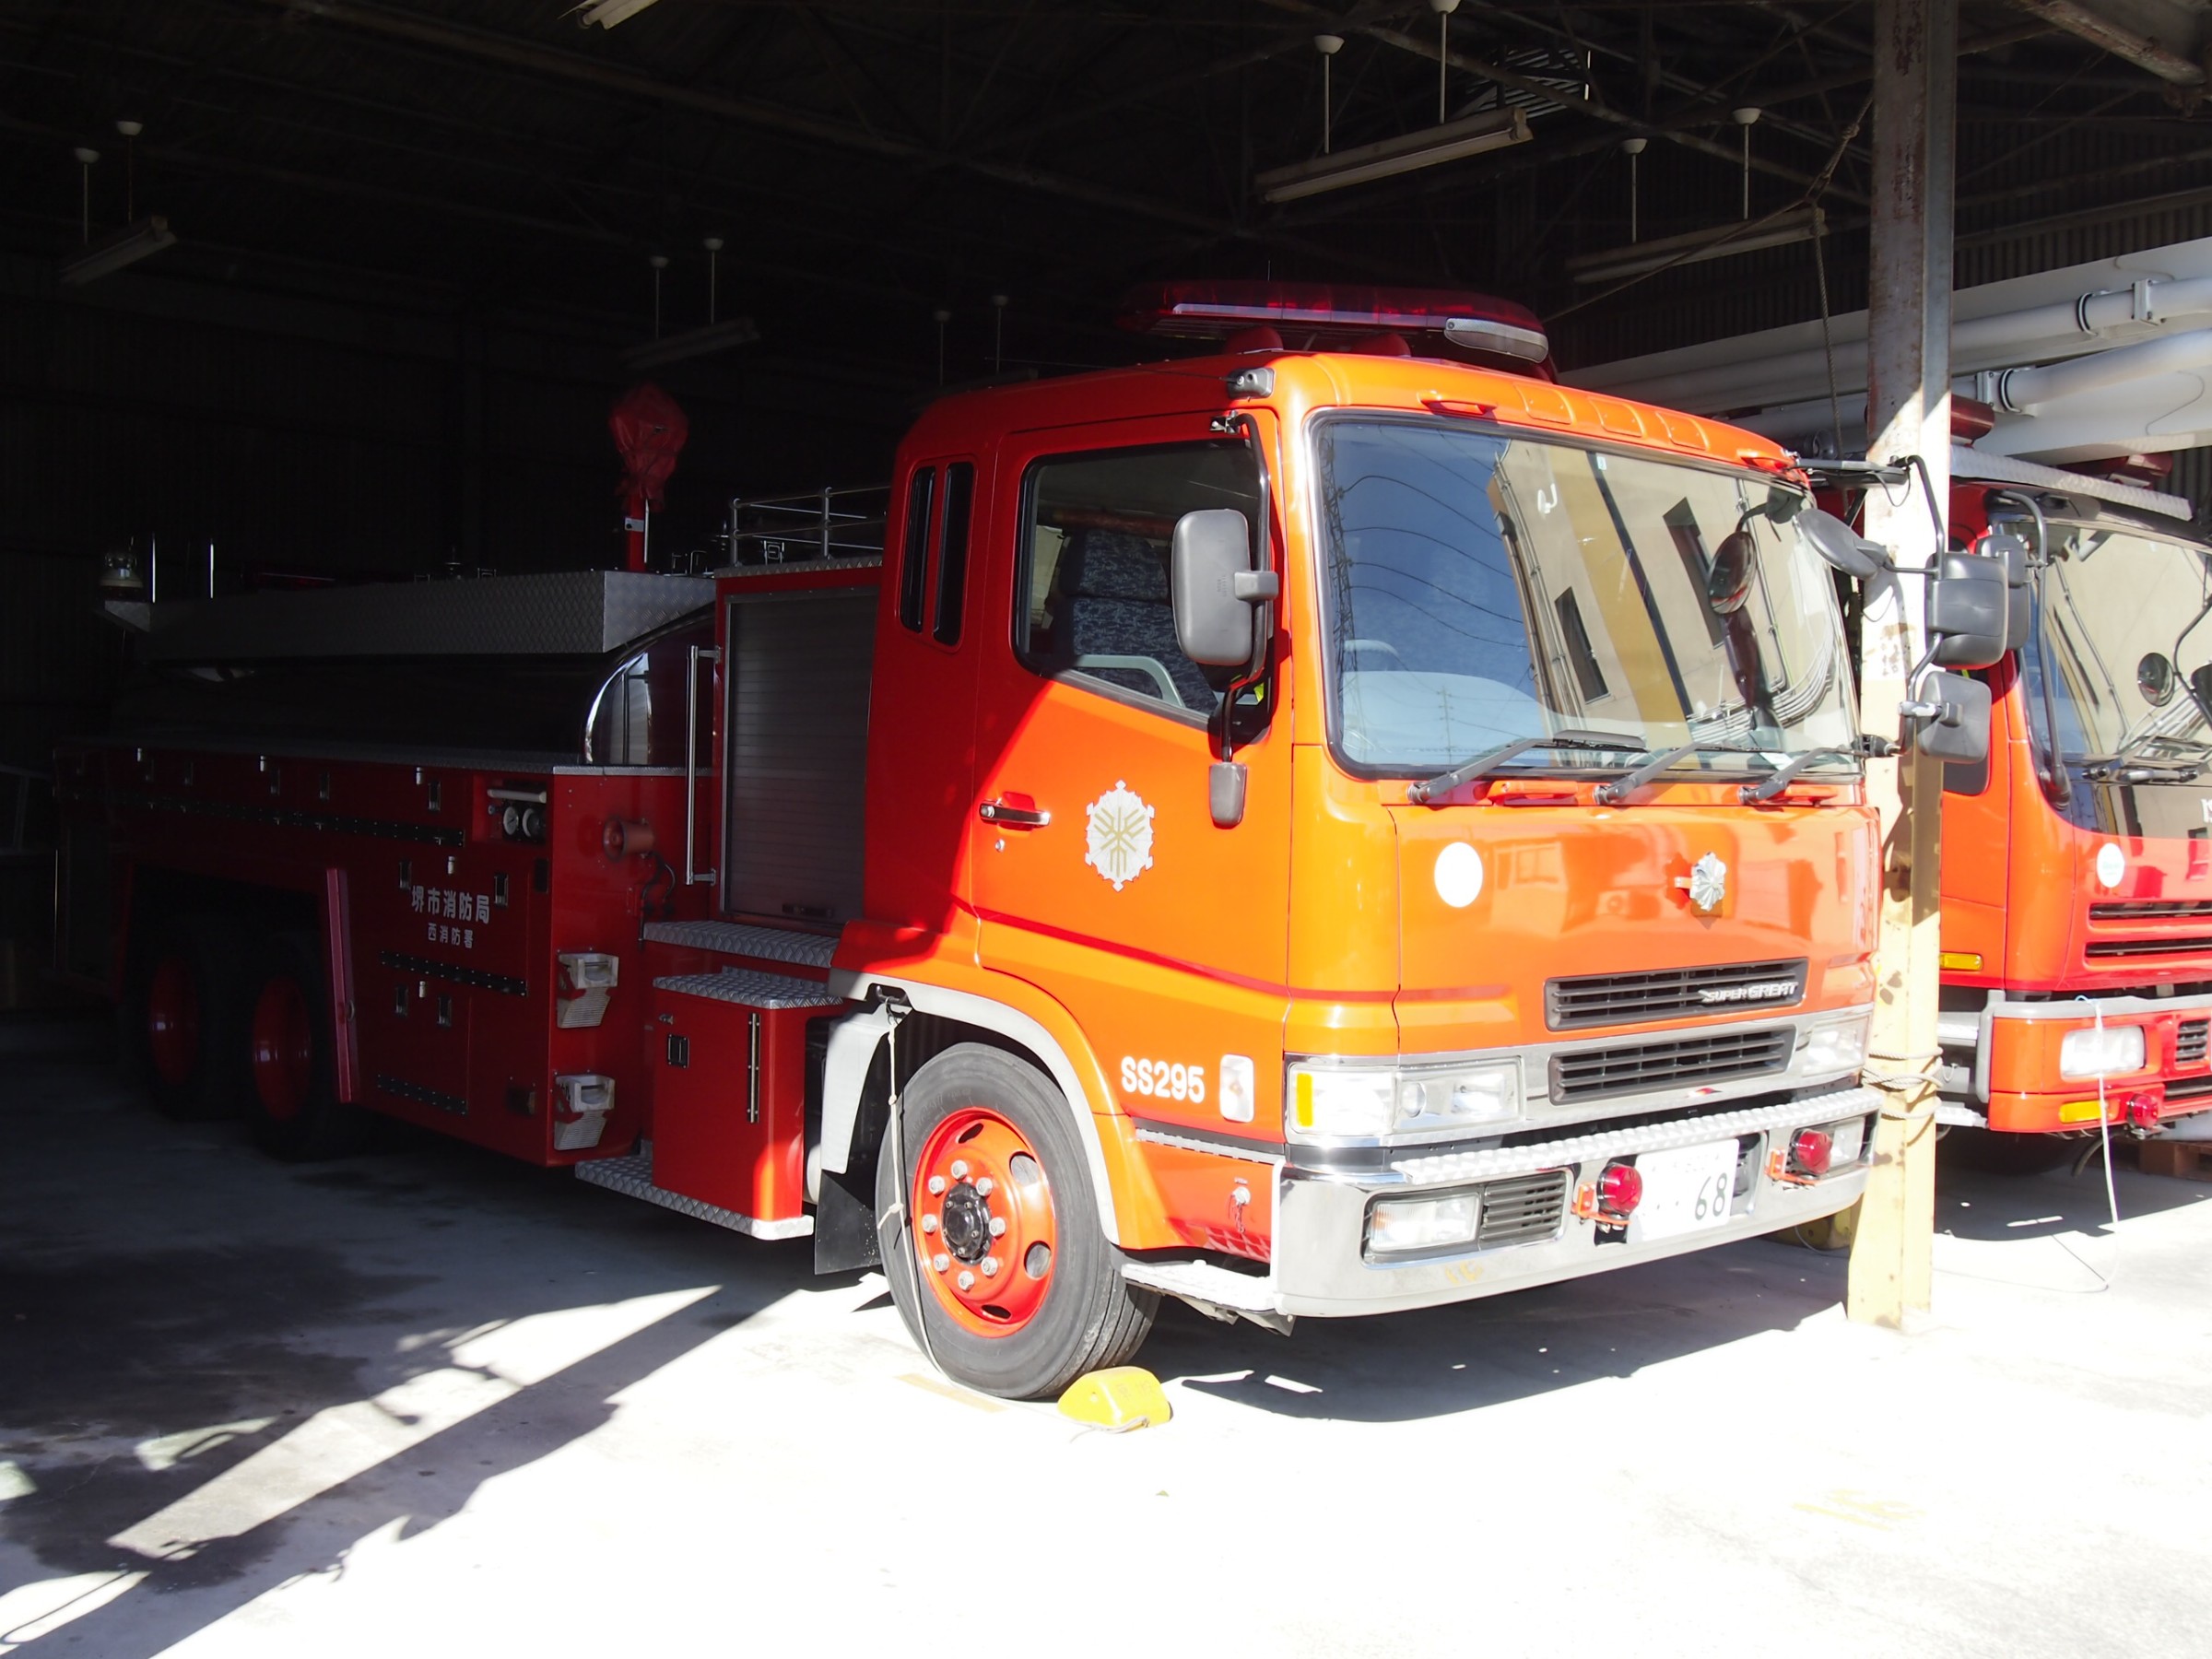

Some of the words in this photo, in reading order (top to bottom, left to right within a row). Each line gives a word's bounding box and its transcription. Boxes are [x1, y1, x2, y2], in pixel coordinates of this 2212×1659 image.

[411, 885, 490, 924] 堺市消防局
[428, 923, 474, 949] 西消防署
[1698, 988, 1747, 1003] SUPER
[1747, 982, 1798, 1000] GREAT
[1121, 1056, 1206, 1103] SS295
